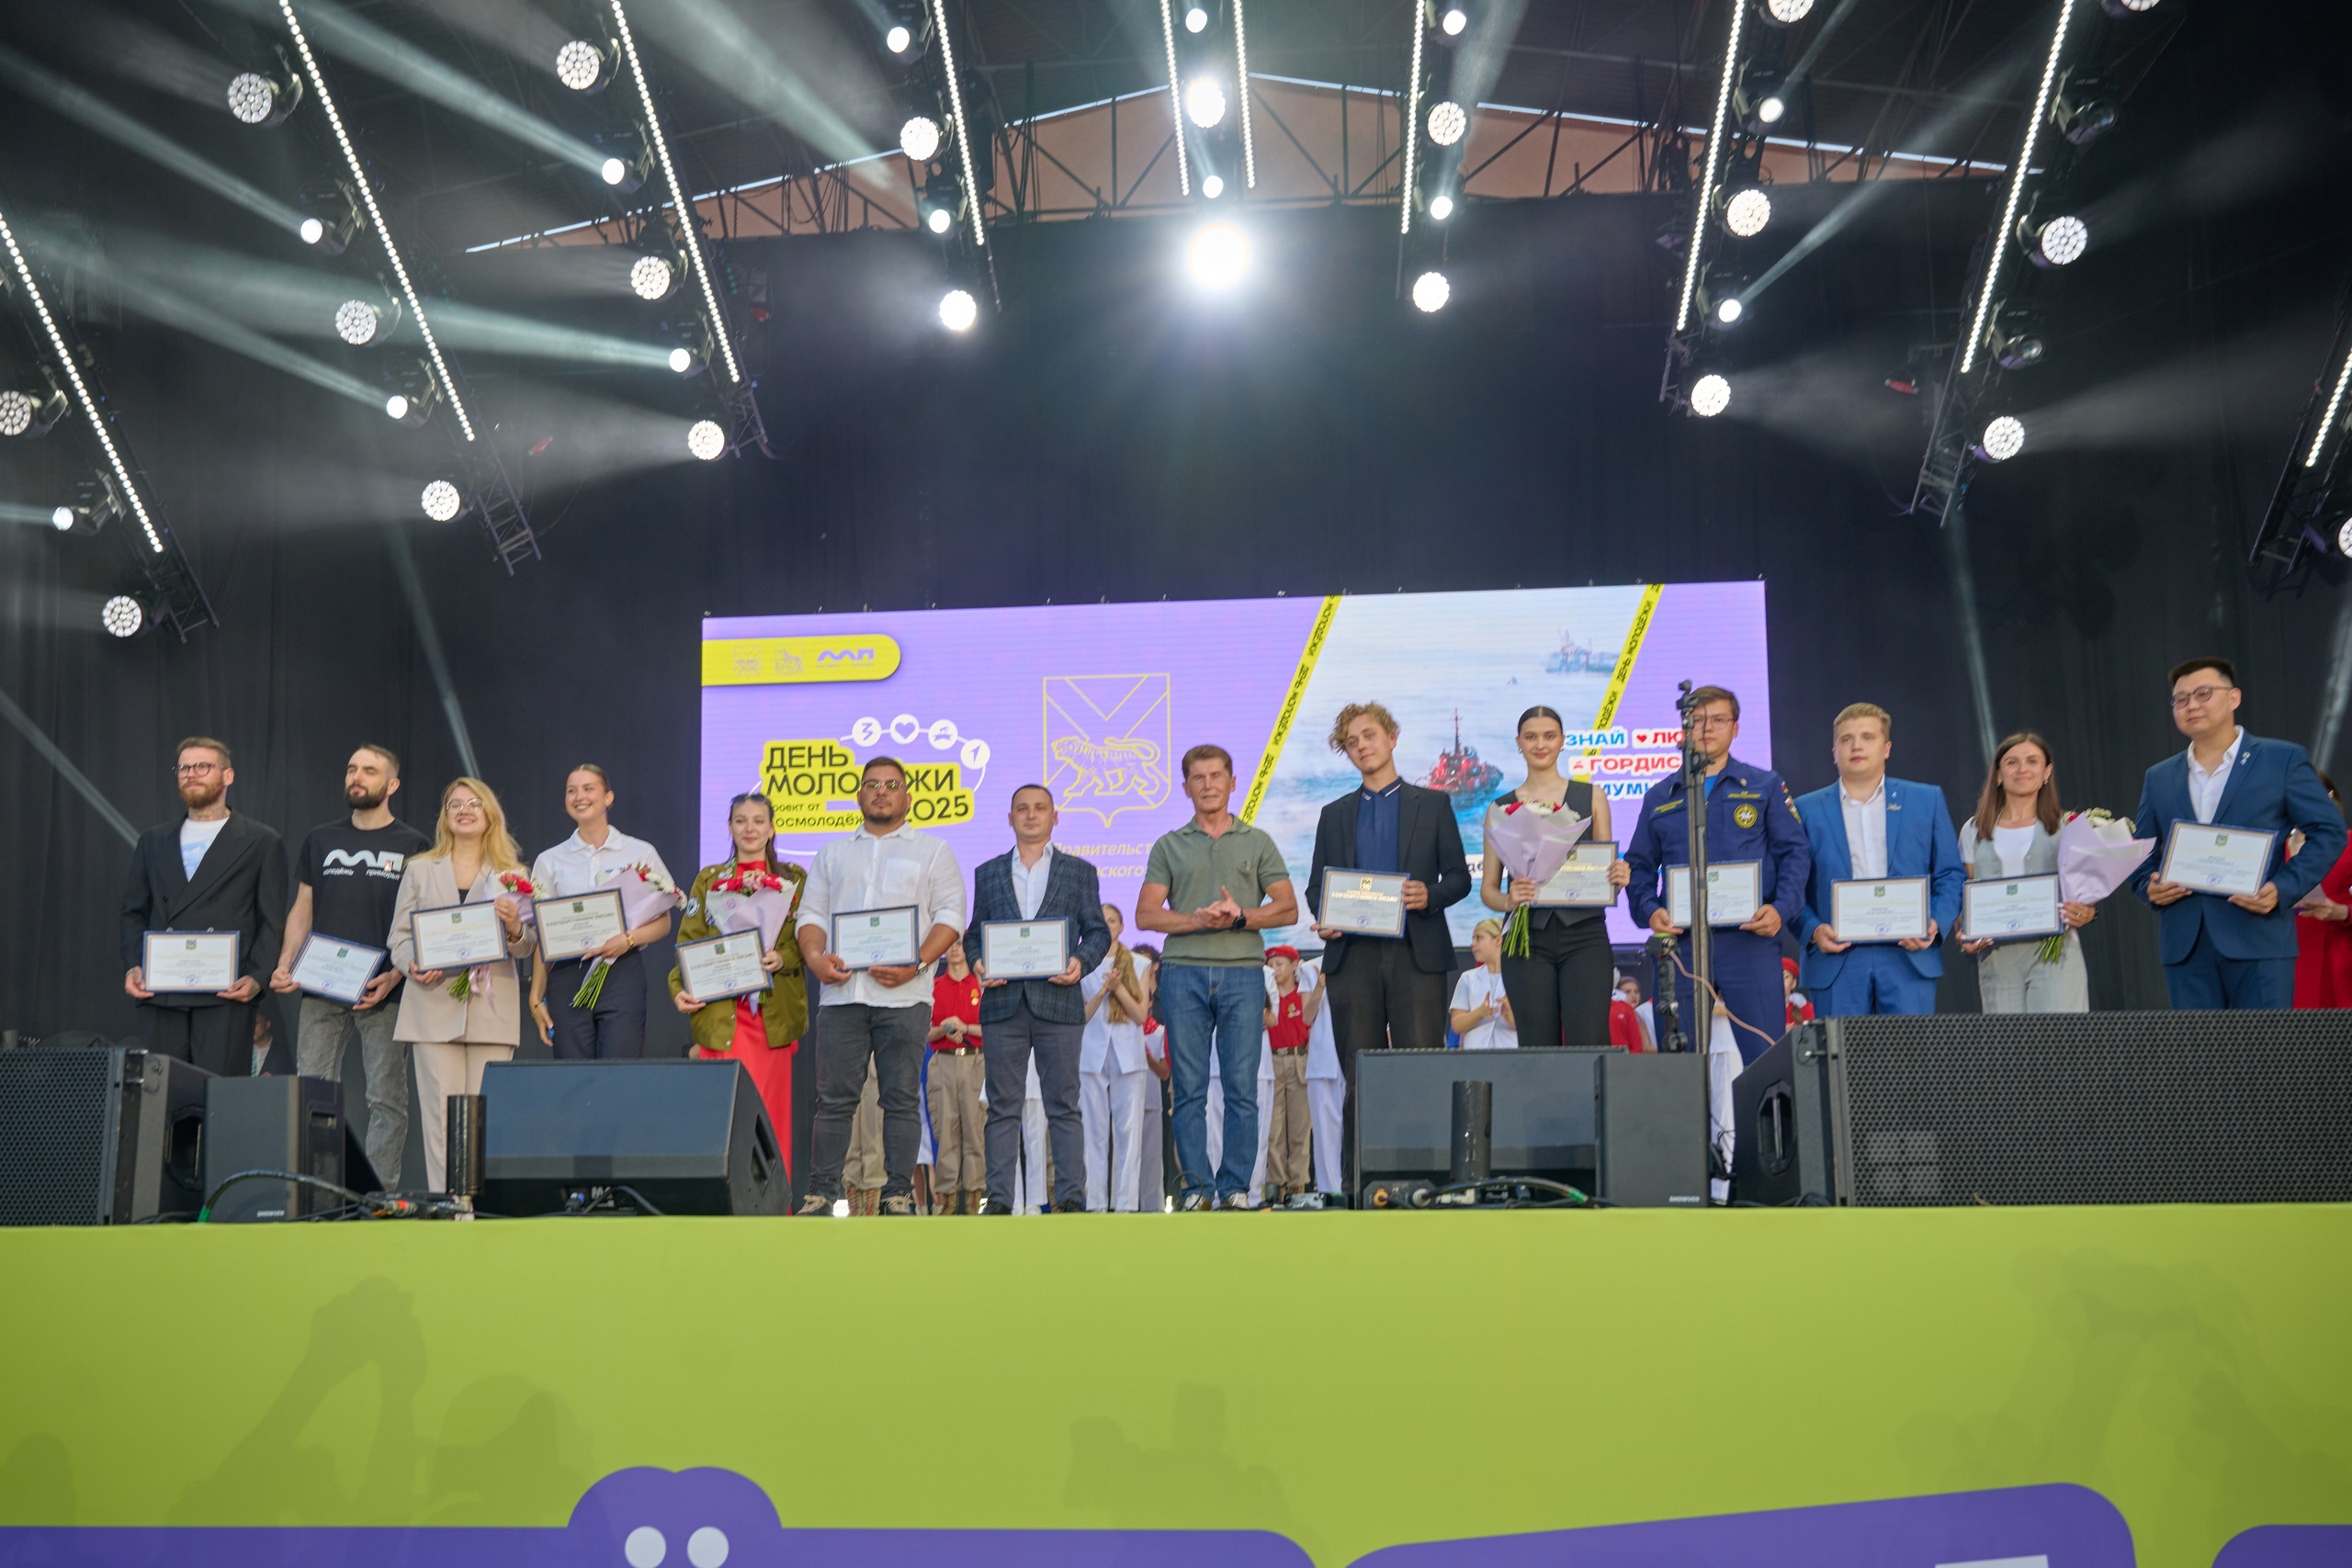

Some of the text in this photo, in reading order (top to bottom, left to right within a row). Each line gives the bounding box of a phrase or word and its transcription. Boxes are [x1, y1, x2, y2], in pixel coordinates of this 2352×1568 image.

[1565, 729, 1685, 746] ЗНАЙ ЛЮ
[765, 745, 848, 773] ДЕНЬ
[1590, 757, 1681, 773] ГОРДИС
[766, 769, 954, 795] МОЛОЖИ
[808, 804, 820, 812] от
[775, 814, 865, 828] осмолодёж
